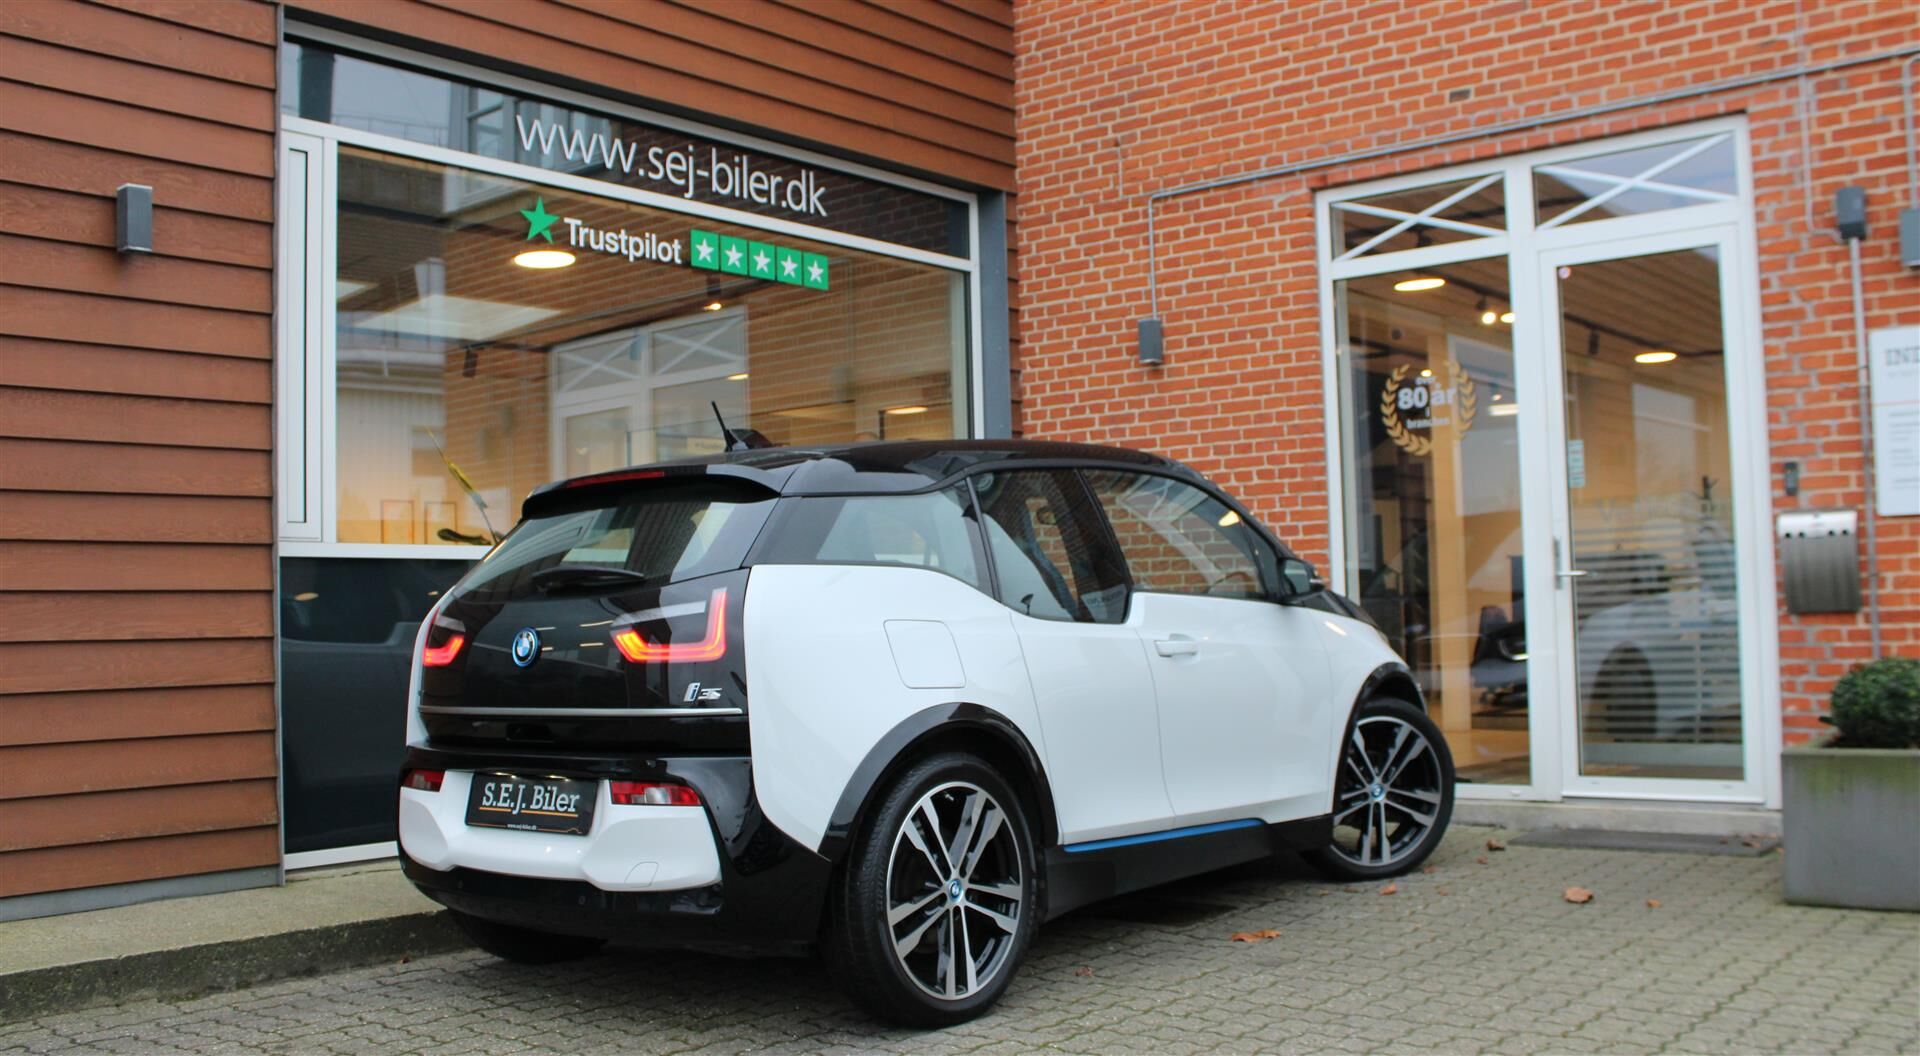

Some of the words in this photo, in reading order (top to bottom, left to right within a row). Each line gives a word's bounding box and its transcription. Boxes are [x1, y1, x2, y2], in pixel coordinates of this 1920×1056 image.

[516, 114, 827, 217] www.sej-biler.dk
[563, 216, 682, 264] Trustpilot
[1398, 387, 1428, 410] 80
[1430, 383, 1457, 406] år
[482, 782, 526, 814] S.E.J.
[530, 785, 580, 812] Biler
